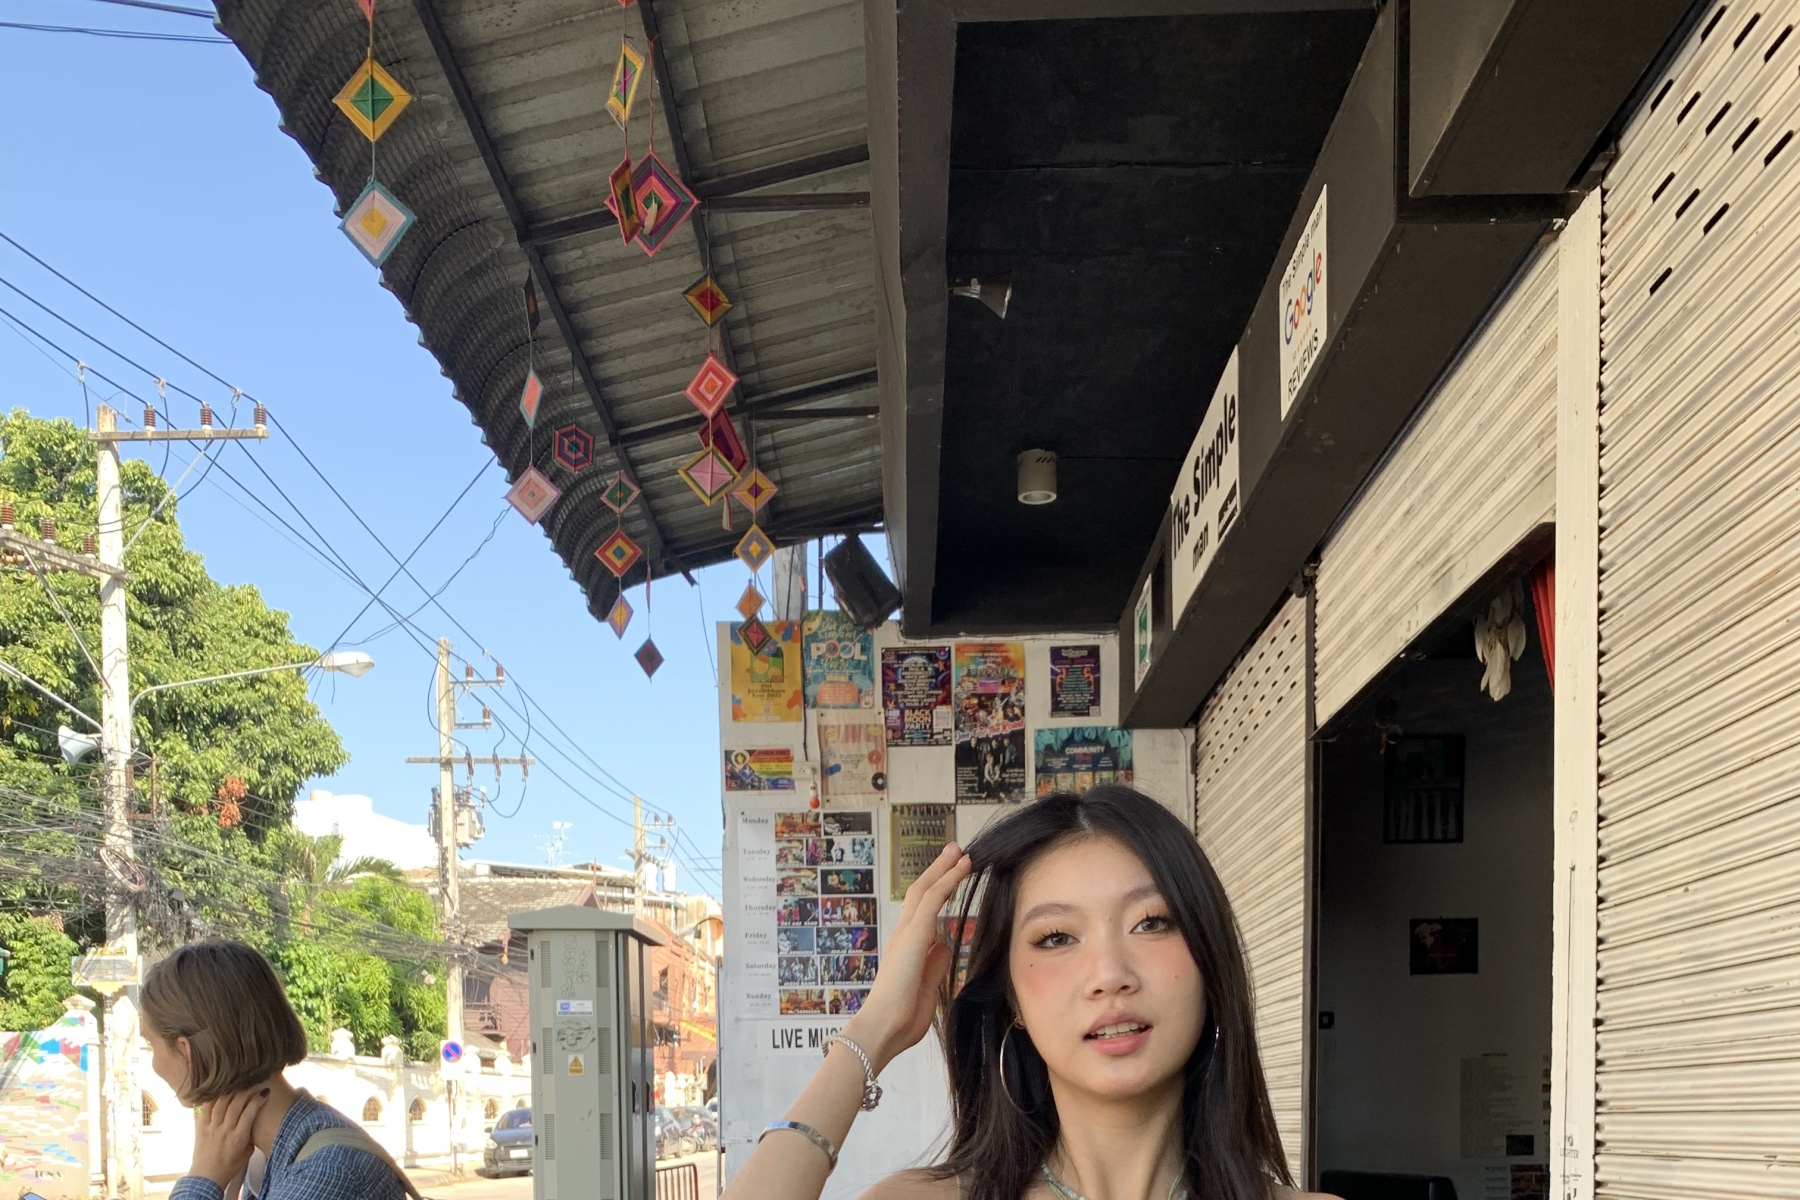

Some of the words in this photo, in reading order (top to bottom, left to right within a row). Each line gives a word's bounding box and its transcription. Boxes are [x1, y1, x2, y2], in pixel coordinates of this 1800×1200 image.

[1282, 276, 1292, 300] The
[1293, 233, 1310, 279] Simple
[1285, 247, 1322, 345] Google
[1288, 327, 1319, 401] REVIEWS
[1173, 494, 1190, 561] The
[1194, 392, 1236, 518] Simple
[1193, 521, 1209, 573] man
[811, 640, 867, 661] POOL
[1001, 717, 1025, 734] Road
[1065, 746, 1105, 755] COMMUNITY
[742, 817, 769, 826] Monday
[743, 848, 771, 857] Tuesday
[743, 875, 776, 884] Wednesday
[744, 904, 777, 913] Thursday
[745, 931, 768, 941] Friday
[745, 962, 777, 971] Saturday
[746, 992, 772, 1002] Sunday
[772, 1028, 804, 1049] LIVE
